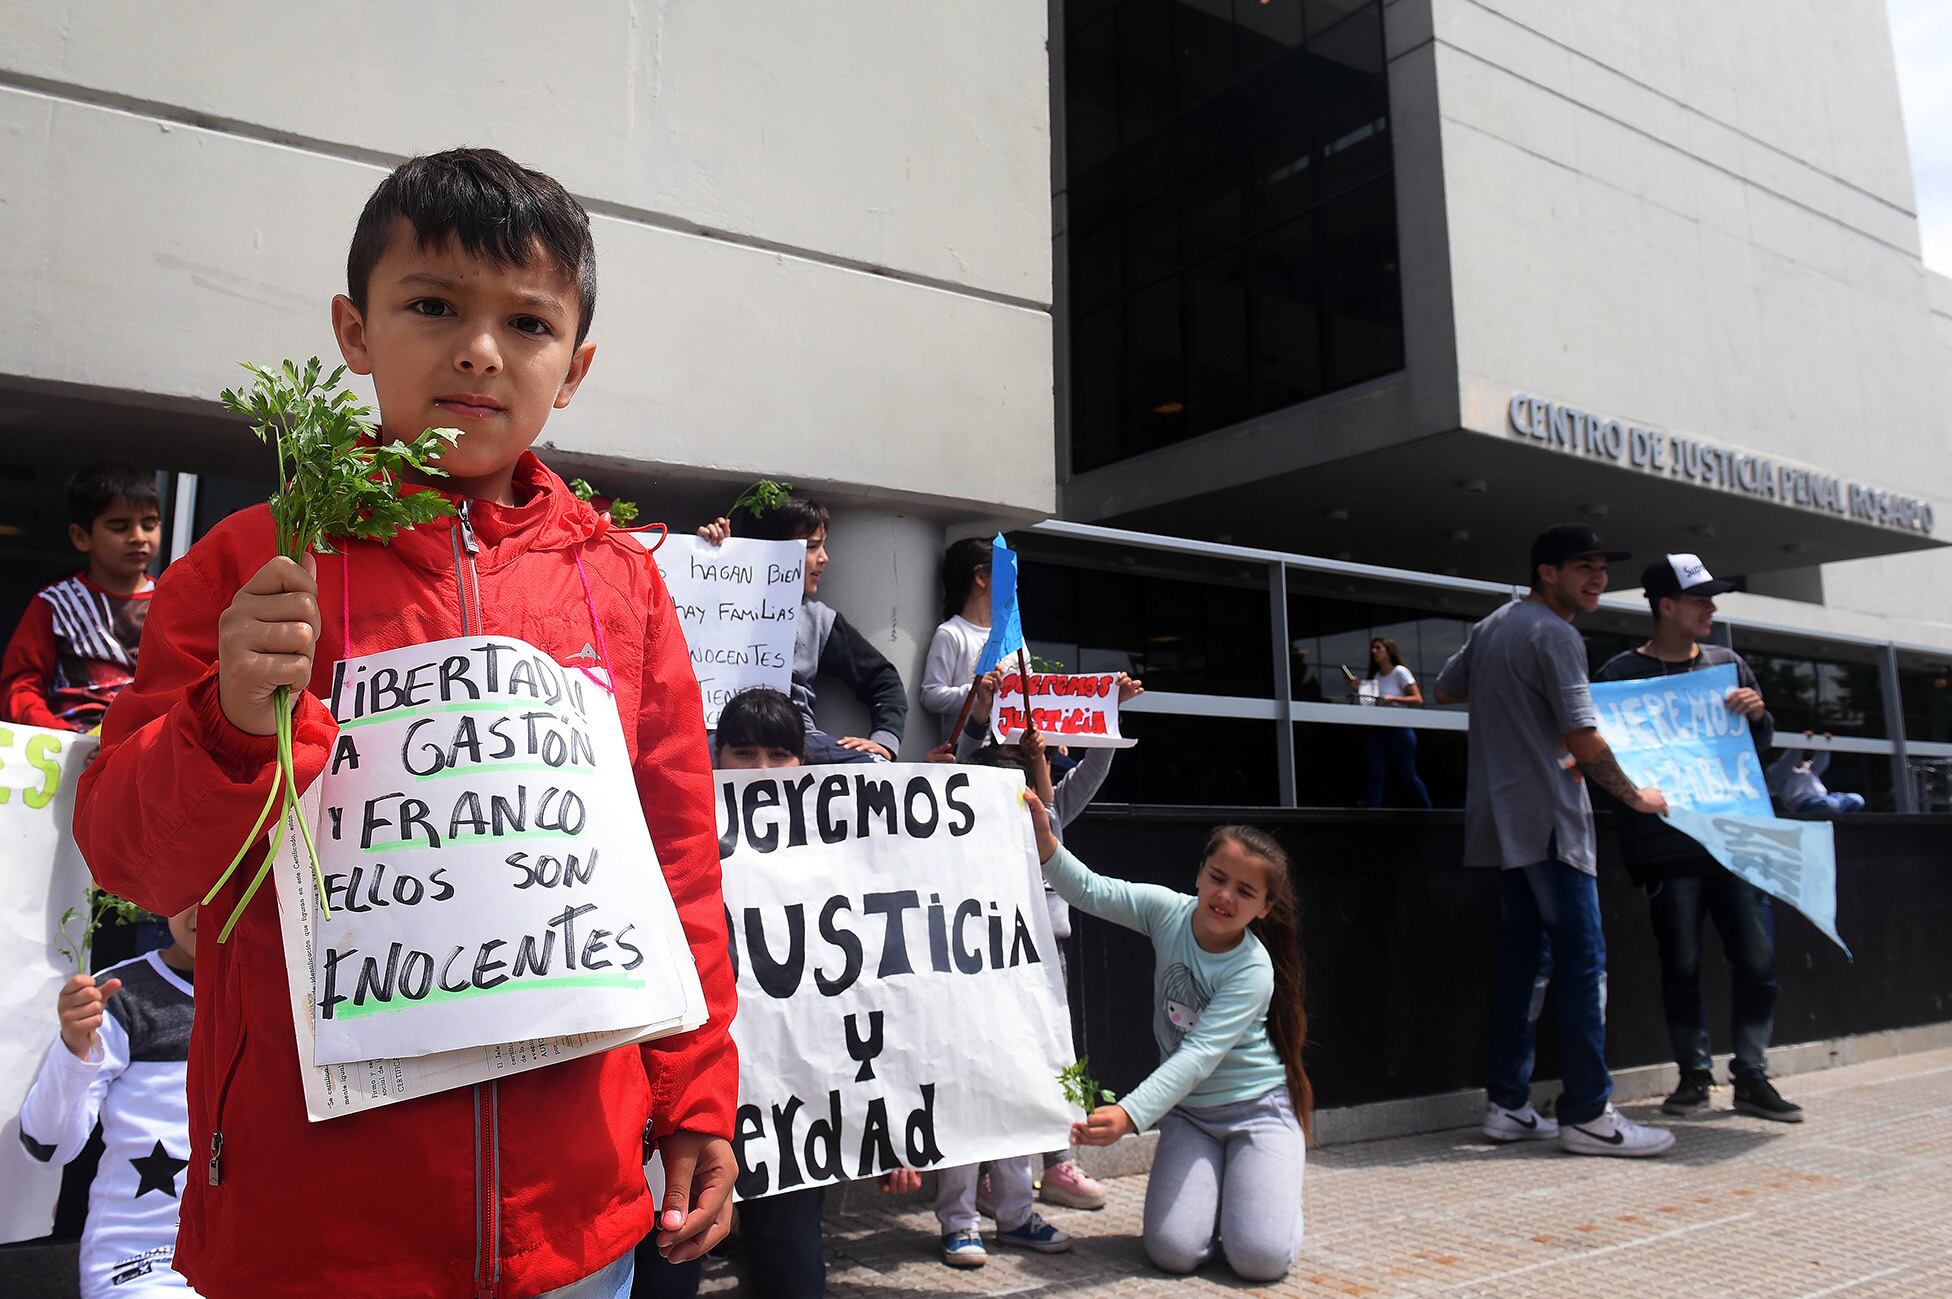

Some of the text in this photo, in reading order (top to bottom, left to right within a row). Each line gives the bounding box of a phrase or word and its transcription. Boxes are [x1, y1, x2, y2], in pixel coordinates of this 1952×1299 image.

[1508, 394, 1935, 535] CENTRO DE JUSTICIA PENAL ROSARIO
[689, 643, 786, 669] NOCENTES
[331, 735, 361, 775] A
[328, 784, 587, 849] Y FRANCO
[718, 773, 975, 861] ueremos
[289, 833, 300, 870] Certificado,
[321, 863, 456, 912] ELLOS
[505, 847, 599, 888] SON
[305, 940, 316, 984] identificación
[316, 903, 645, 1019] INOCENTES
[724, 889, 1041, 999] USTiCiA
[371, 1079, 379, 1099] Firma
[731, 1082, 946, 1200] erdAd
